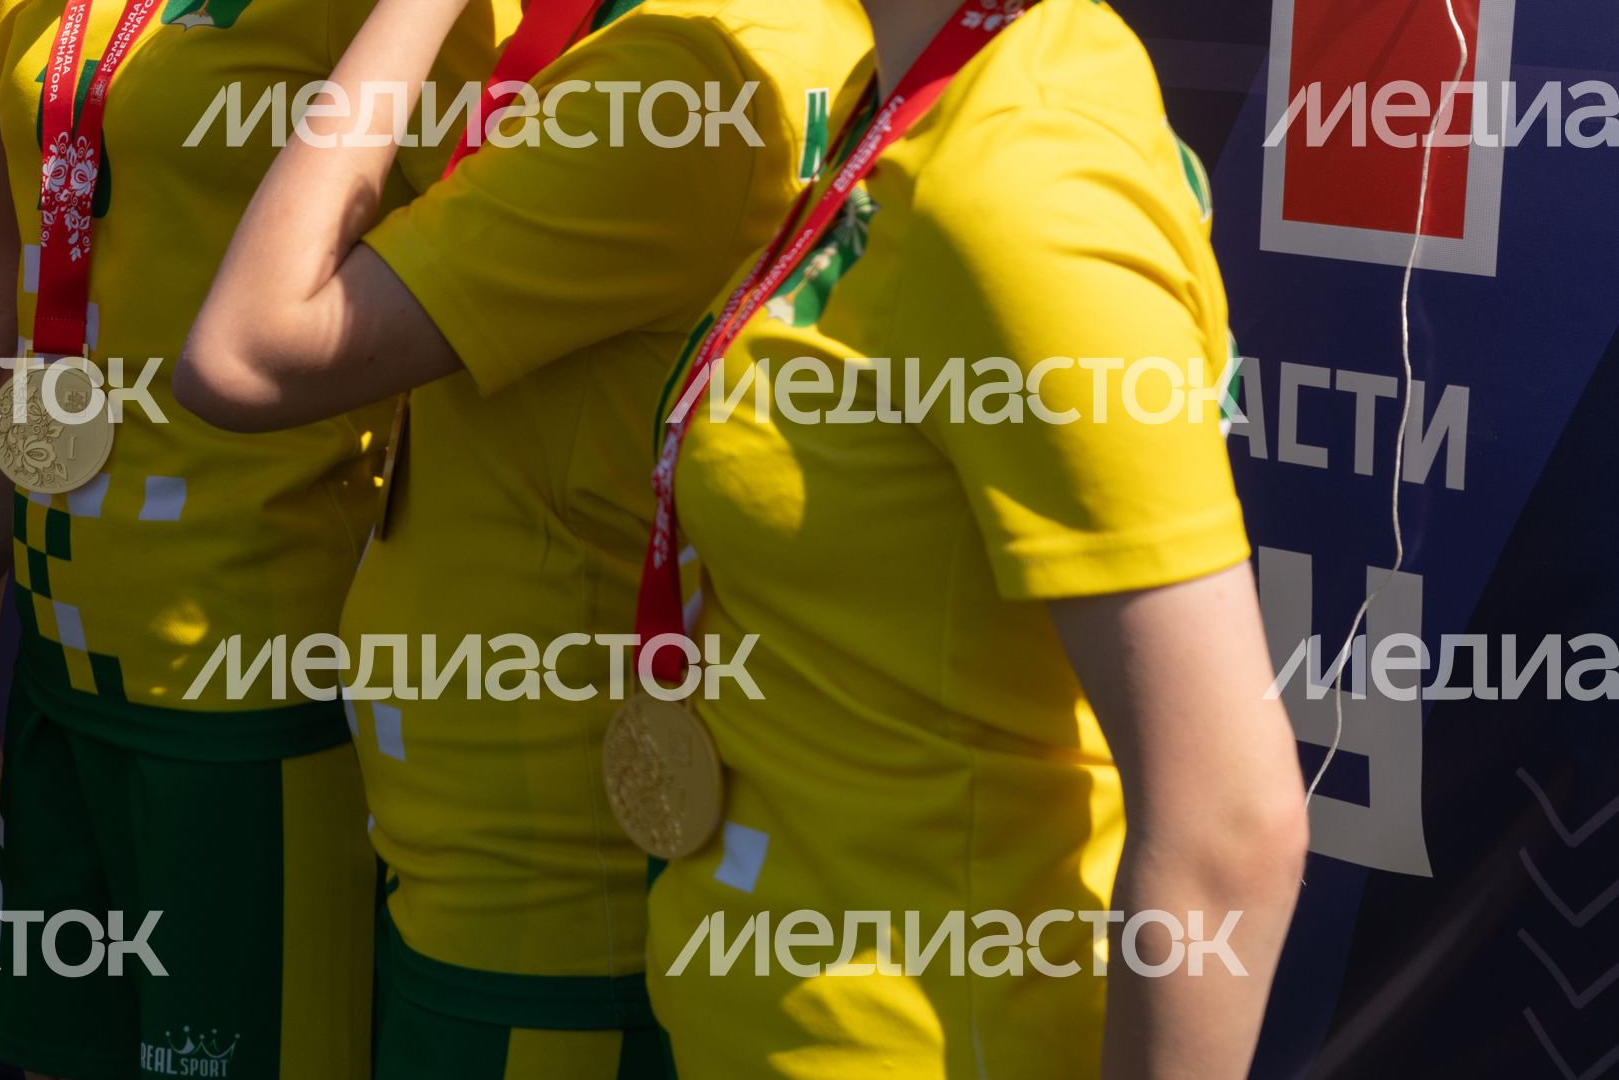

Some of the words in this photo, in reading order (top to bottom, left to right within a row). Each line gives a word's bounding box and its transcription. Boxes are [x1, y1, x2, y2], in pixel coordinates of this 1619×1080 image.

[49, 6, 78, 103] ГУБЕРНАТОРА
[62, 4, 86, 75] КОМАНДА
[101, 3, 142, 72] КОМАНДА
[141, 1041, 177, 1075] REAL
[180, 1058, 229, 1078] SPORT
